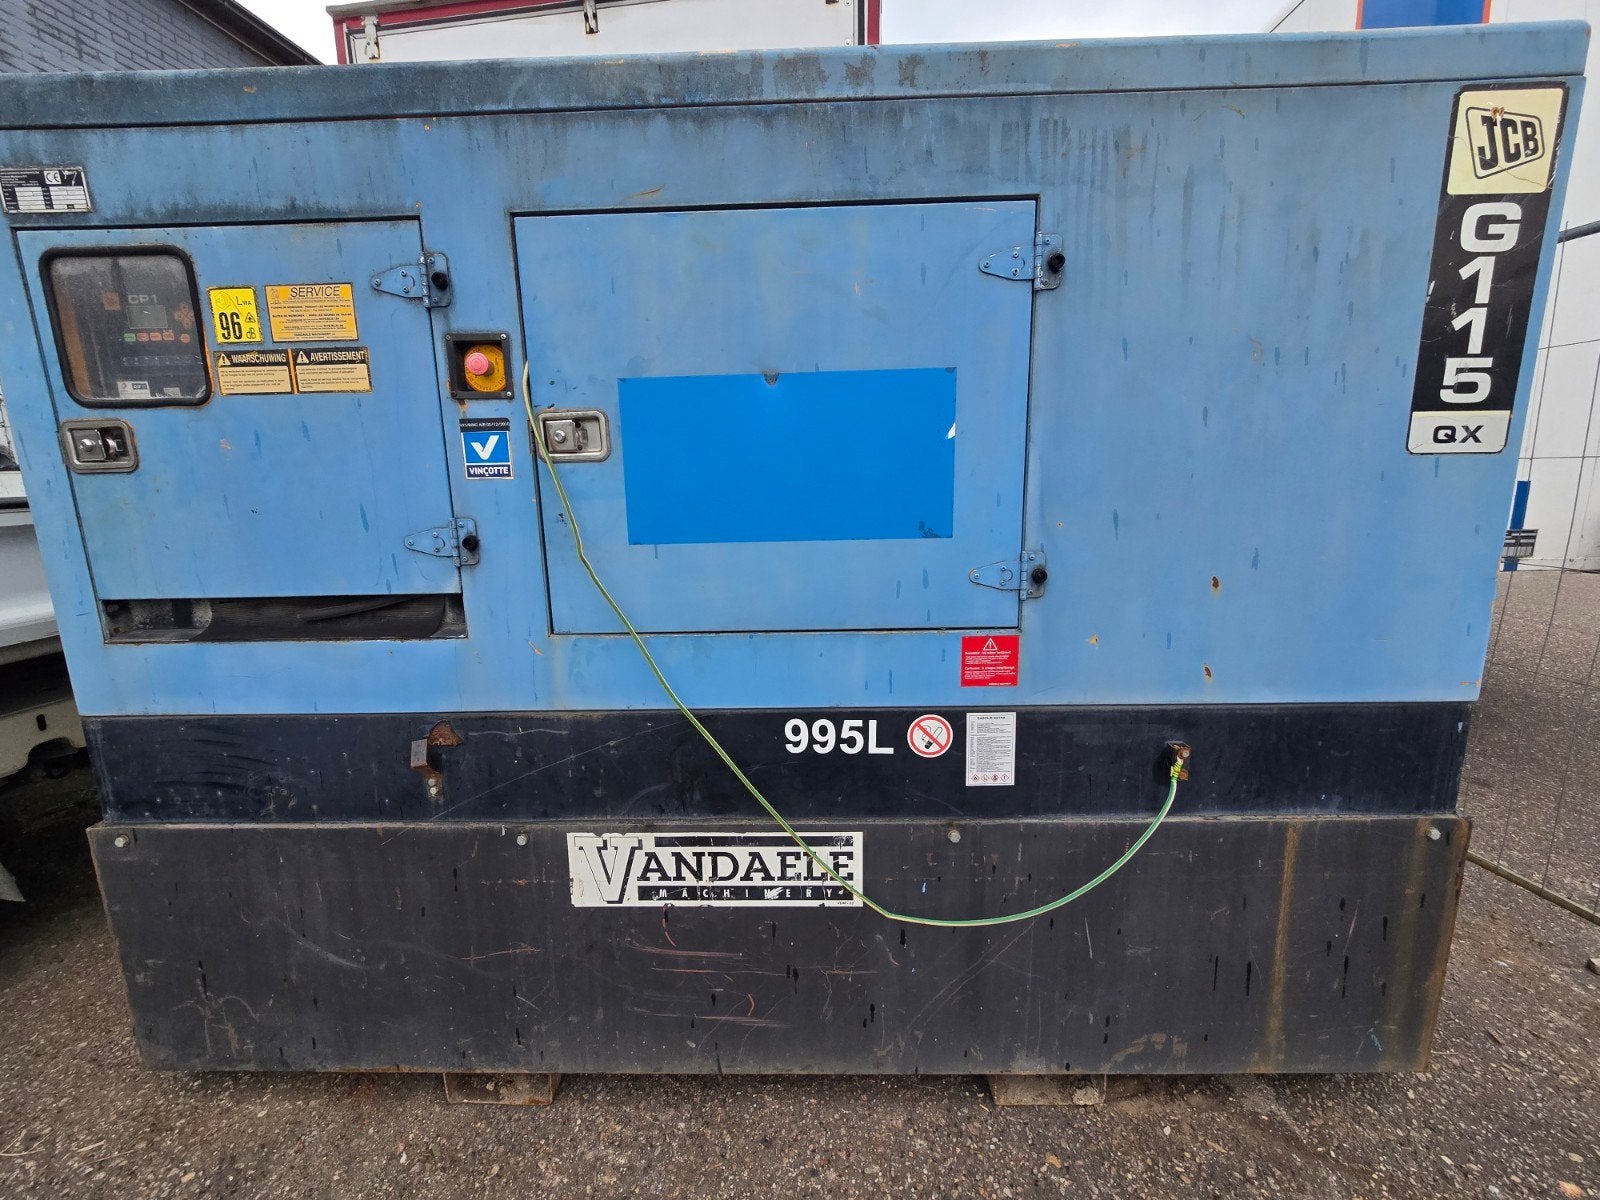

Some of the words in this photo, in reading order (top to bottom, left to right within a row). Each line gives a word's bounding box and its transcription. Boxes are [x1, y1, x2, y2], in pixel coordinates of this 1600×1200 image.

[1477, 114, 1539, 170] JCB
[290, 286, 341, 298] SERVICE
[218, 312, 243, 341] 96
[231, 353, 287, 364] WAARSCHUWING
[310, 350, 365, 362] AVERTISSEMENT
[1432, 425, 1485, 444] QX
[469, 466, 509, 477] VINÇOTTE
[784, 718, 894, 755] 995L
[574, 836, 854, 904] VANDAELE
[658, 888, 833, 898] MACHINERY
